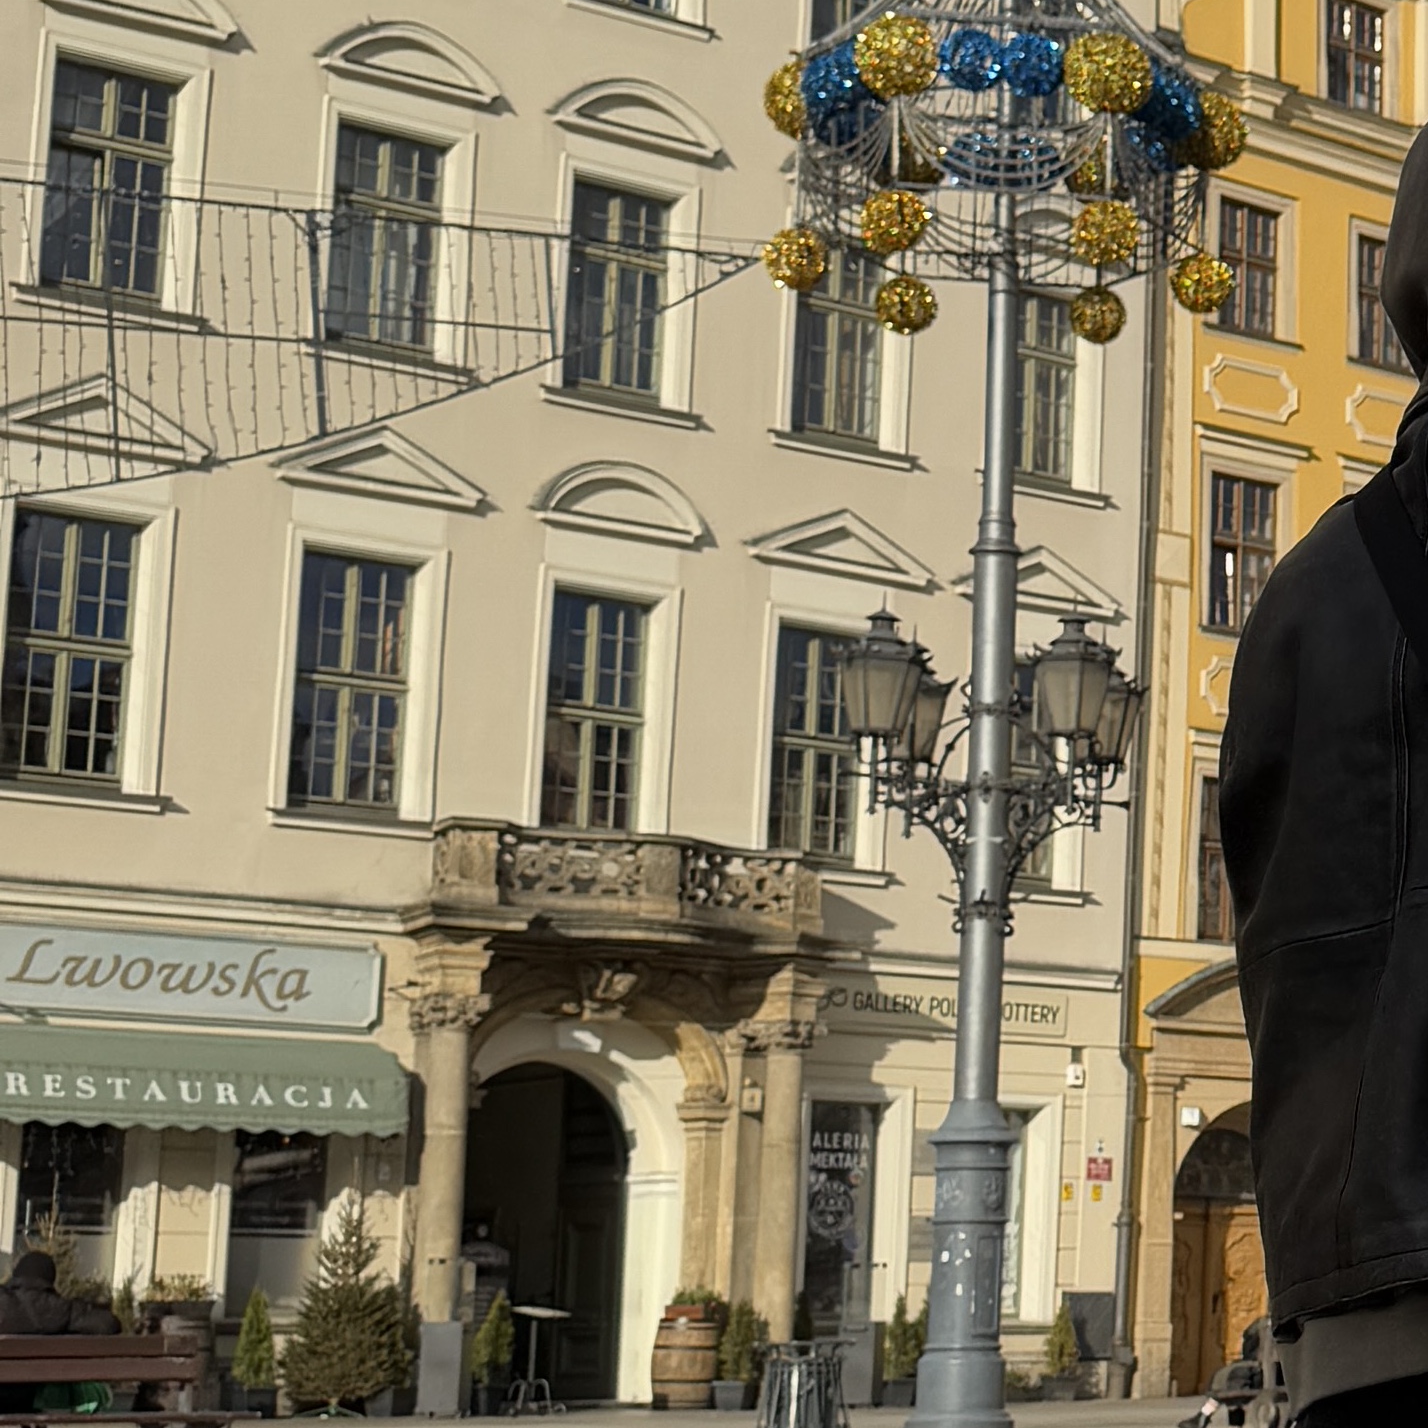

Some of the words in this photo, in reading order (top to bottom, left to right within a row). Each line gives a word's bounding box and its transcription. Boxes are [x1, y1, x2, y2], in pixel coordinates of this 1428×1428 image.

[6, 938, 312, 1013] Lwowska
[853, 990, 924, 1014] GALLERY
[929, 996, 958, 1018] POL
[1002, 1002, 1061, 1024] OTTERY
[4, 1072, 370, 1110] RESTAURACJA
[812, 1131, 870, 1150] ALERIA
